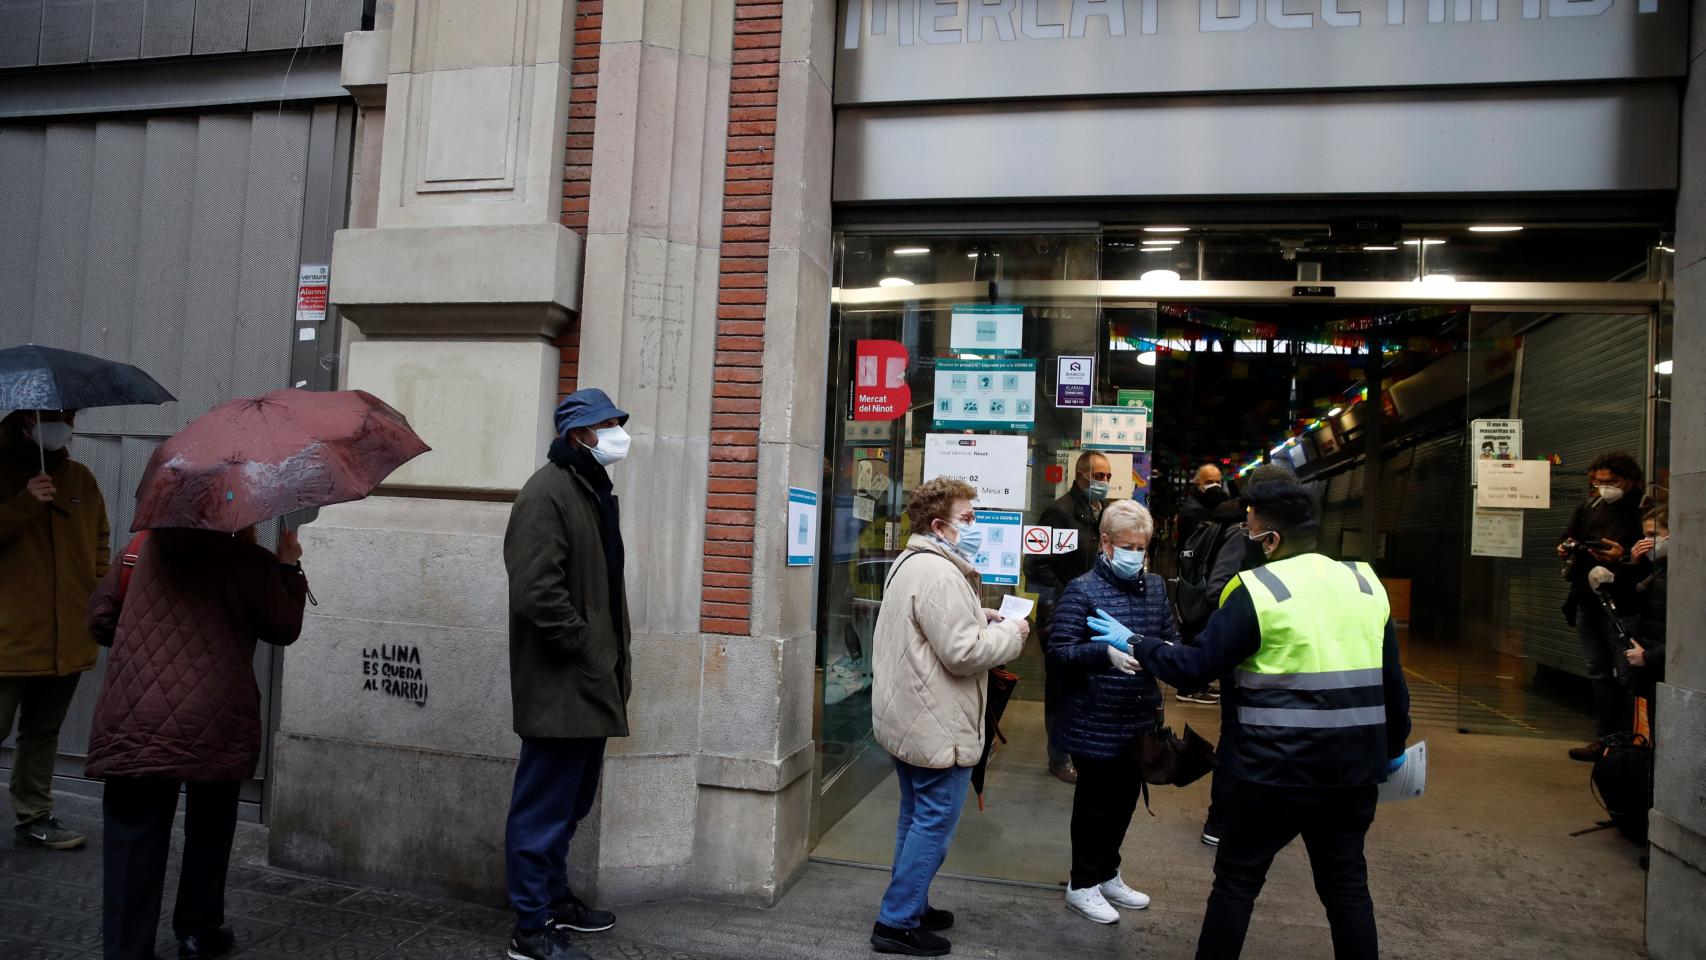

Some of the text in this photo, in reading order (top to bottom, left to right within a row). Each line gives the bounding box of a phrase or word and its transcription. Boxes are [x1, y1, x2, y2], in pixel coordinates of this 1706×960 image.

[859, 395, 887, 403] Mercat
[872, 405, 894, 413] Ninot
[981, 487, 1001, 495] Mesa:
[363, 643, 421, 665] LA LINA
[363, 660, 422, 681] ES QUEDA
[363, 678, 423, 699] AL BARRI
